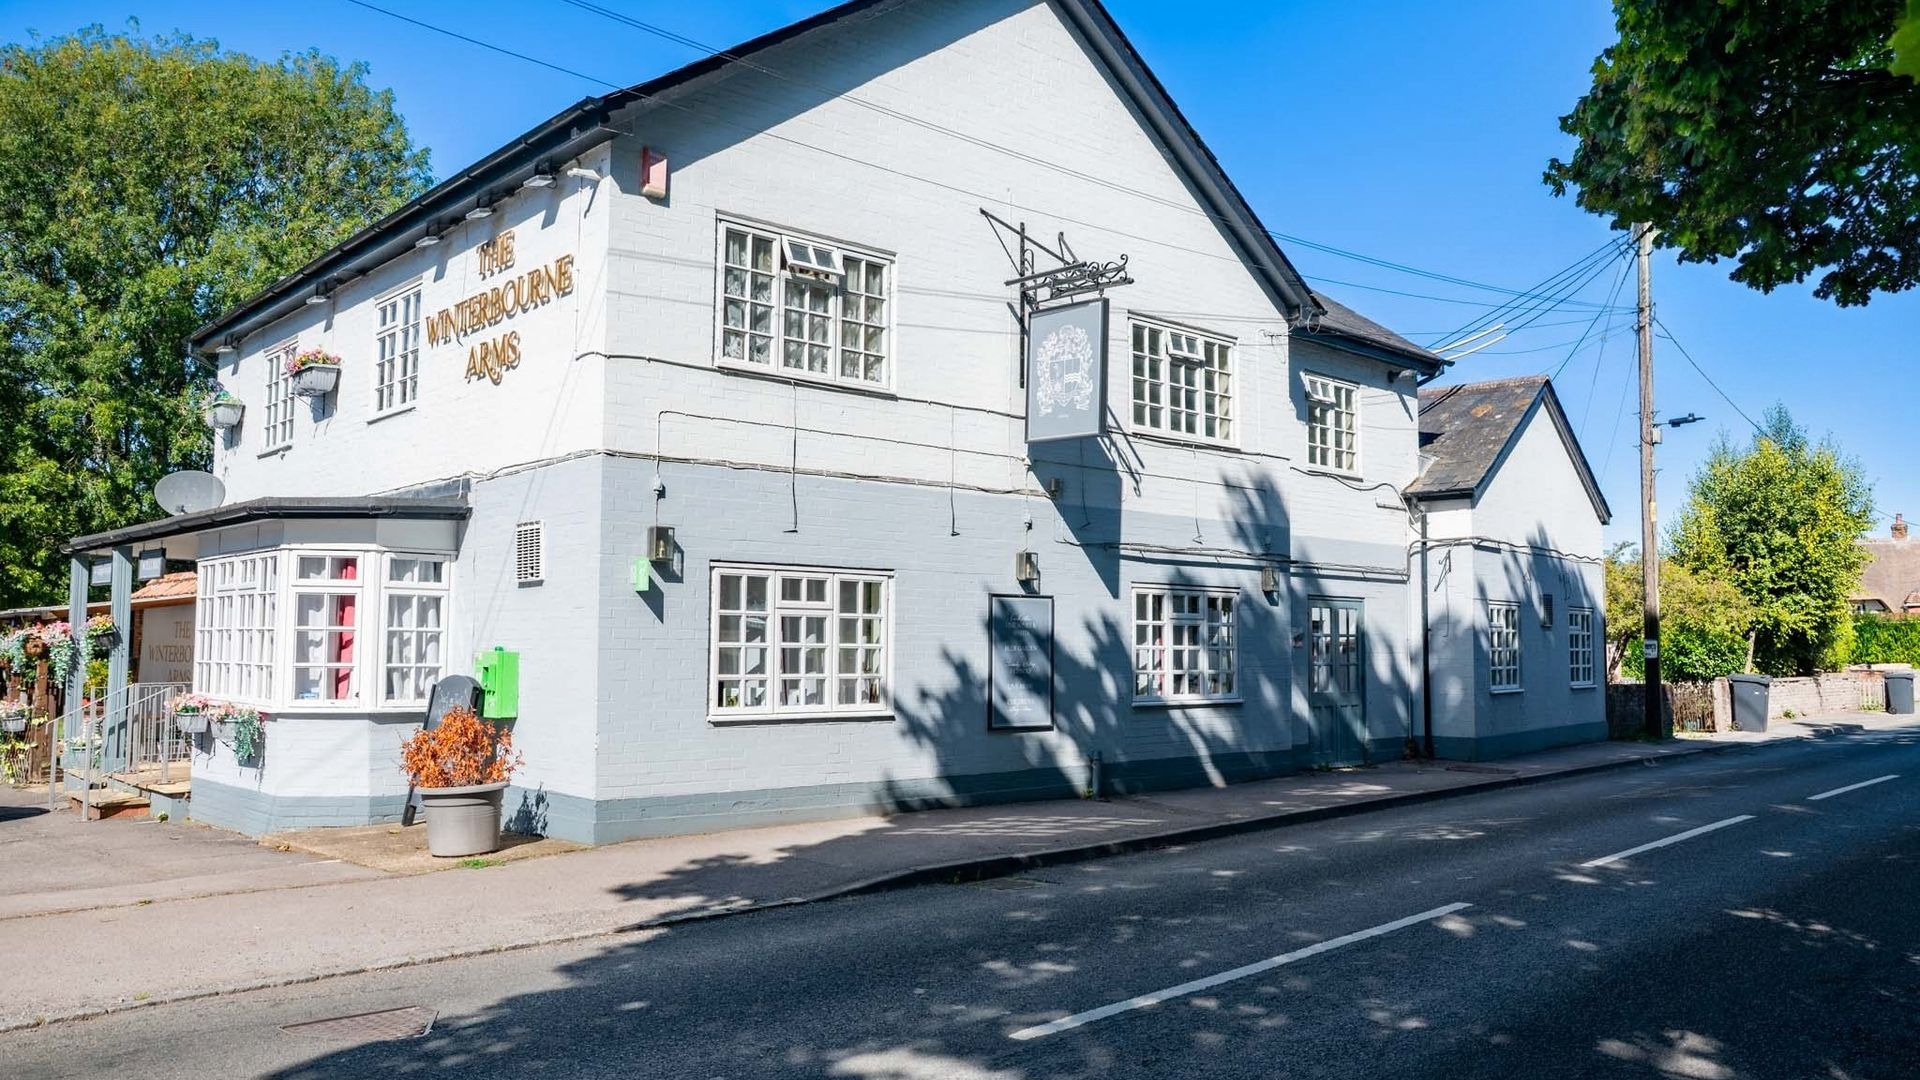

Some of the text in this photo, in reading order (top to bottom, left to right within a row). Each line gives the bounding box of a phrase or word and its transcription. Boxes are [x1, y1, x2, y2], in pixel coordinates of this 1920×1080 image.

[476, 230, 516, 279] THE
[425, 254, 575, 347] WINTERBOURNE
[465, 331, 520, 384] ARMS
[174, 621, 192, 639] THE
